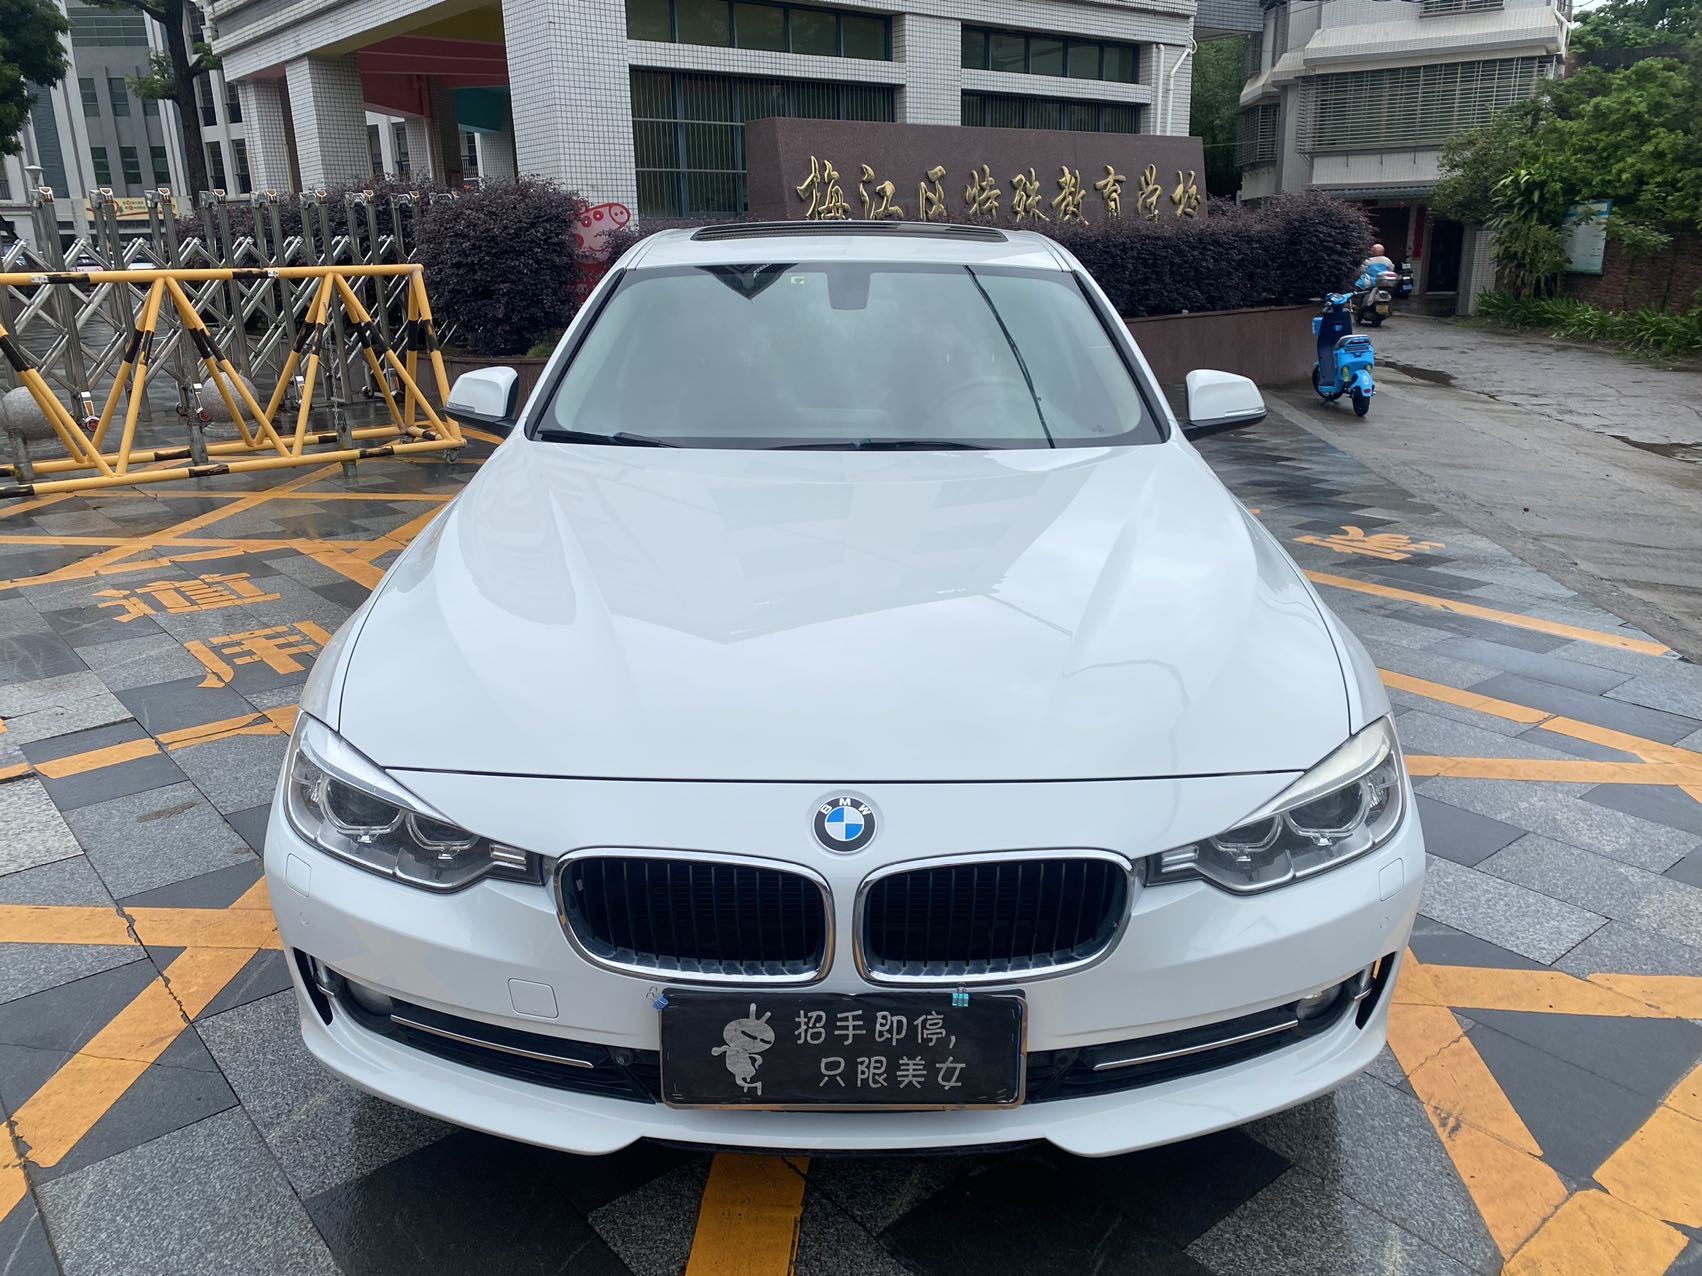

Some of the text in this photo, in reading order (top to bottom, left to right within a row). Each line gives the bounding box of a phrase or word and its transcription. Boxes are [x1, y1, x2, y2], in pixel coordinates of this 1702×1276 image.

[820, 797, 872, 815] BMW
[819, 1056, 966, 1090] 只限美女
